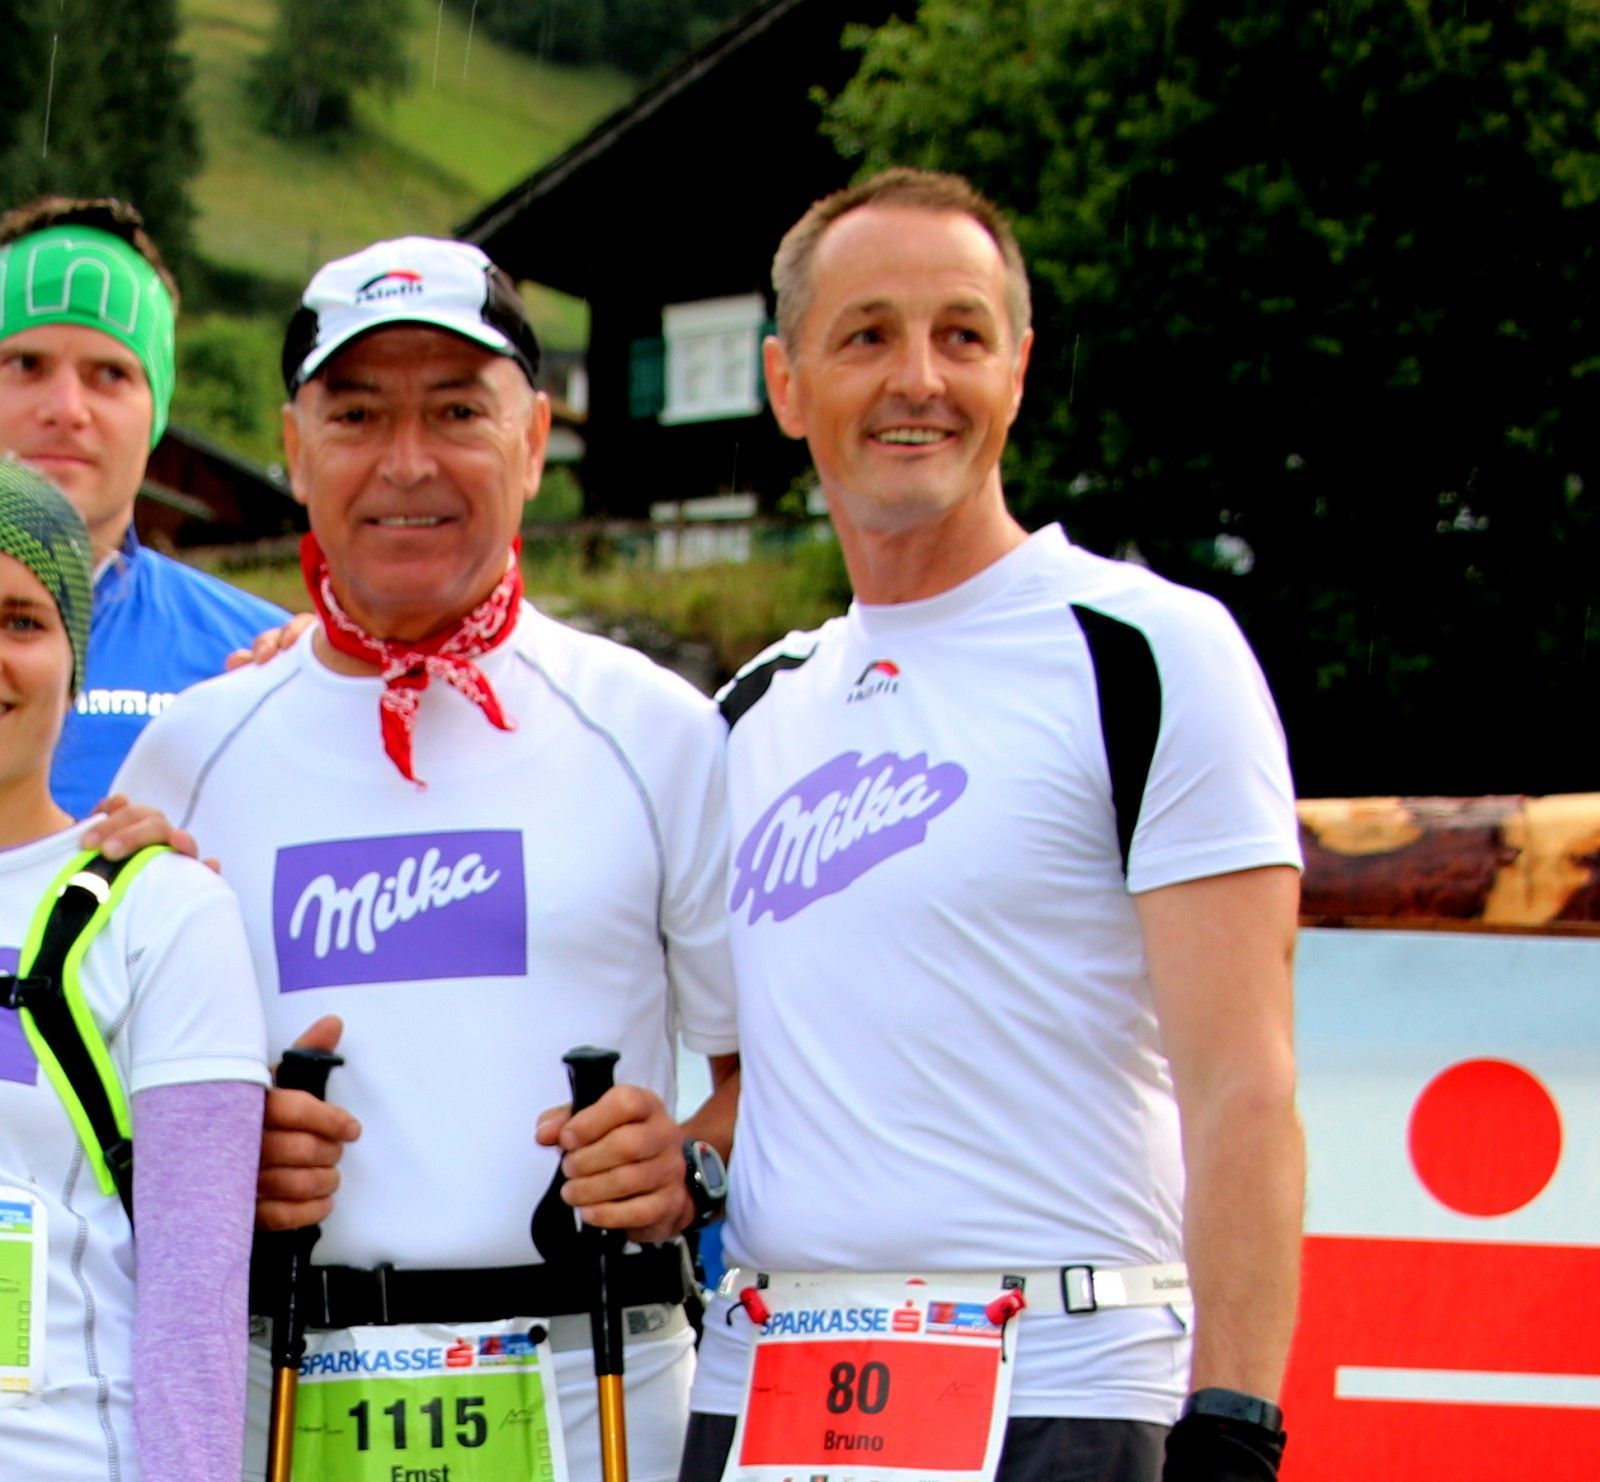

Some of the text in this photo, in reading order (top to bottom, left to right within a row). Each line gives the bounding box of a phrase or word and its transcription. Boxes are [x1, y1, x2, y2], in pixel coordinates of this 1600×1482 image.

[751, 764, 941, 888] Milka
[289, 847, 501, 960] Milka
[758, 1307, 890, 1337] SPARKASSE
[299, 1346, 443, 1377] SPARKASSE
[825, 1360, 891, 1416] 80
[348, 1395, 489, 1452] 1115
[823, 1430, 885, 1452] Bruno
